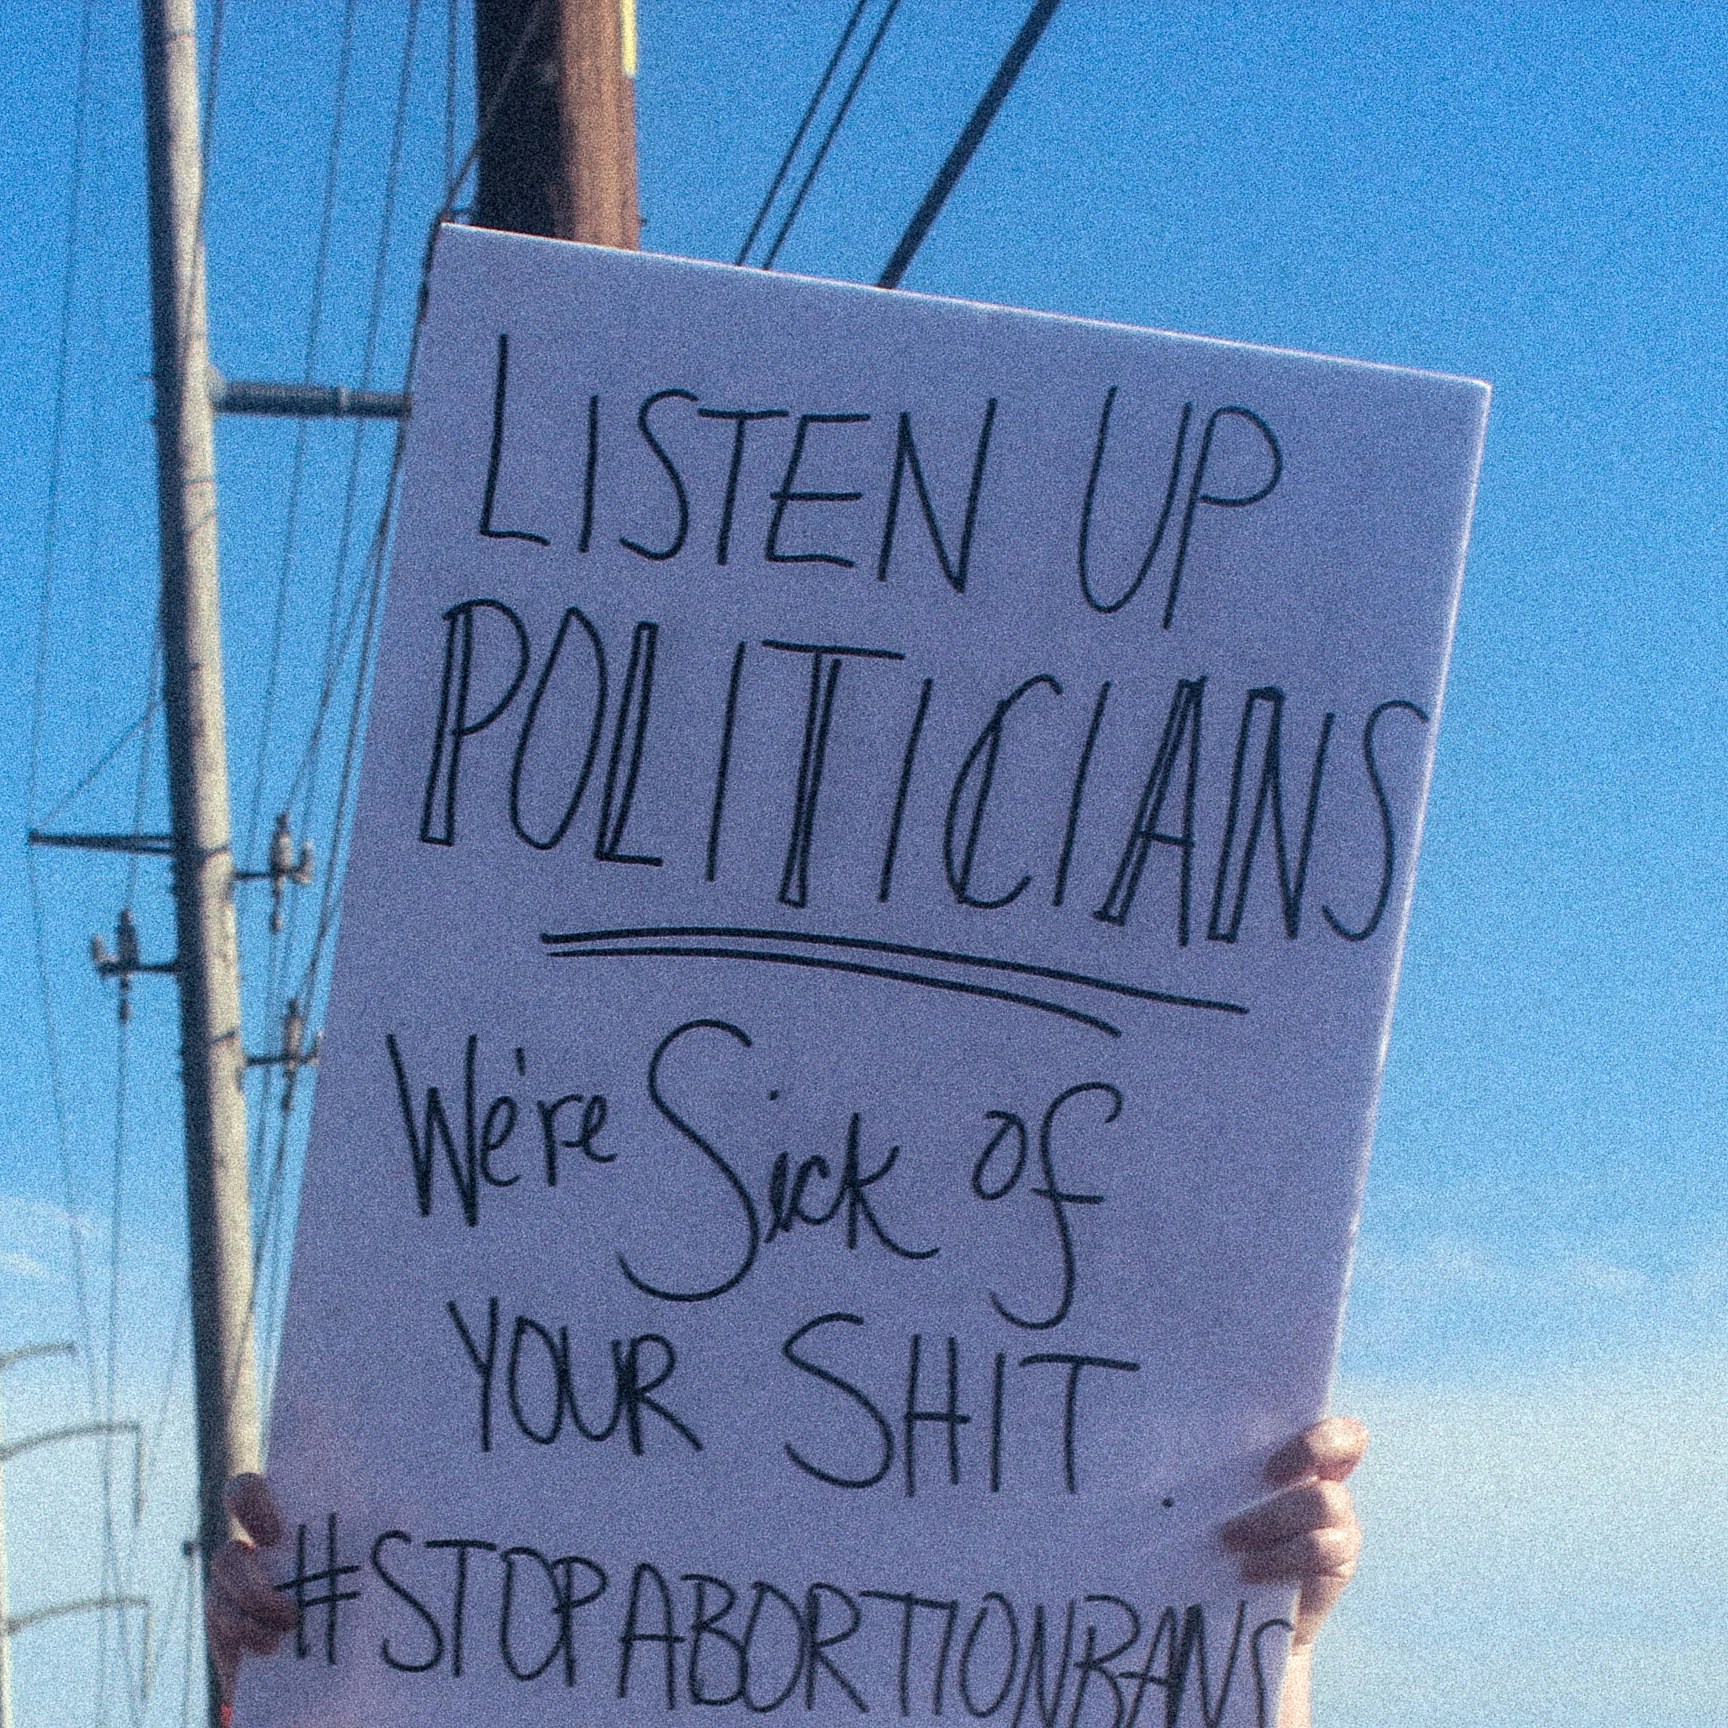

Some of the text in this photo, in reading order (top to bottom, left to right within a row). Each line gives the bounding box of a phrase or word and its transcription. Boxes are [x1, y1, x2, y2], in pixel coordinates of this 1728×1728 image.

[477, 332, 1285, 630] LISTEN UP
[417, 597, 1430, 947] POLITICIANS
[616, 1017, 941, 1303] Sick
[971, 1080, 1123, 1330] of
[446, 1295, 705, 1456] YOUR
